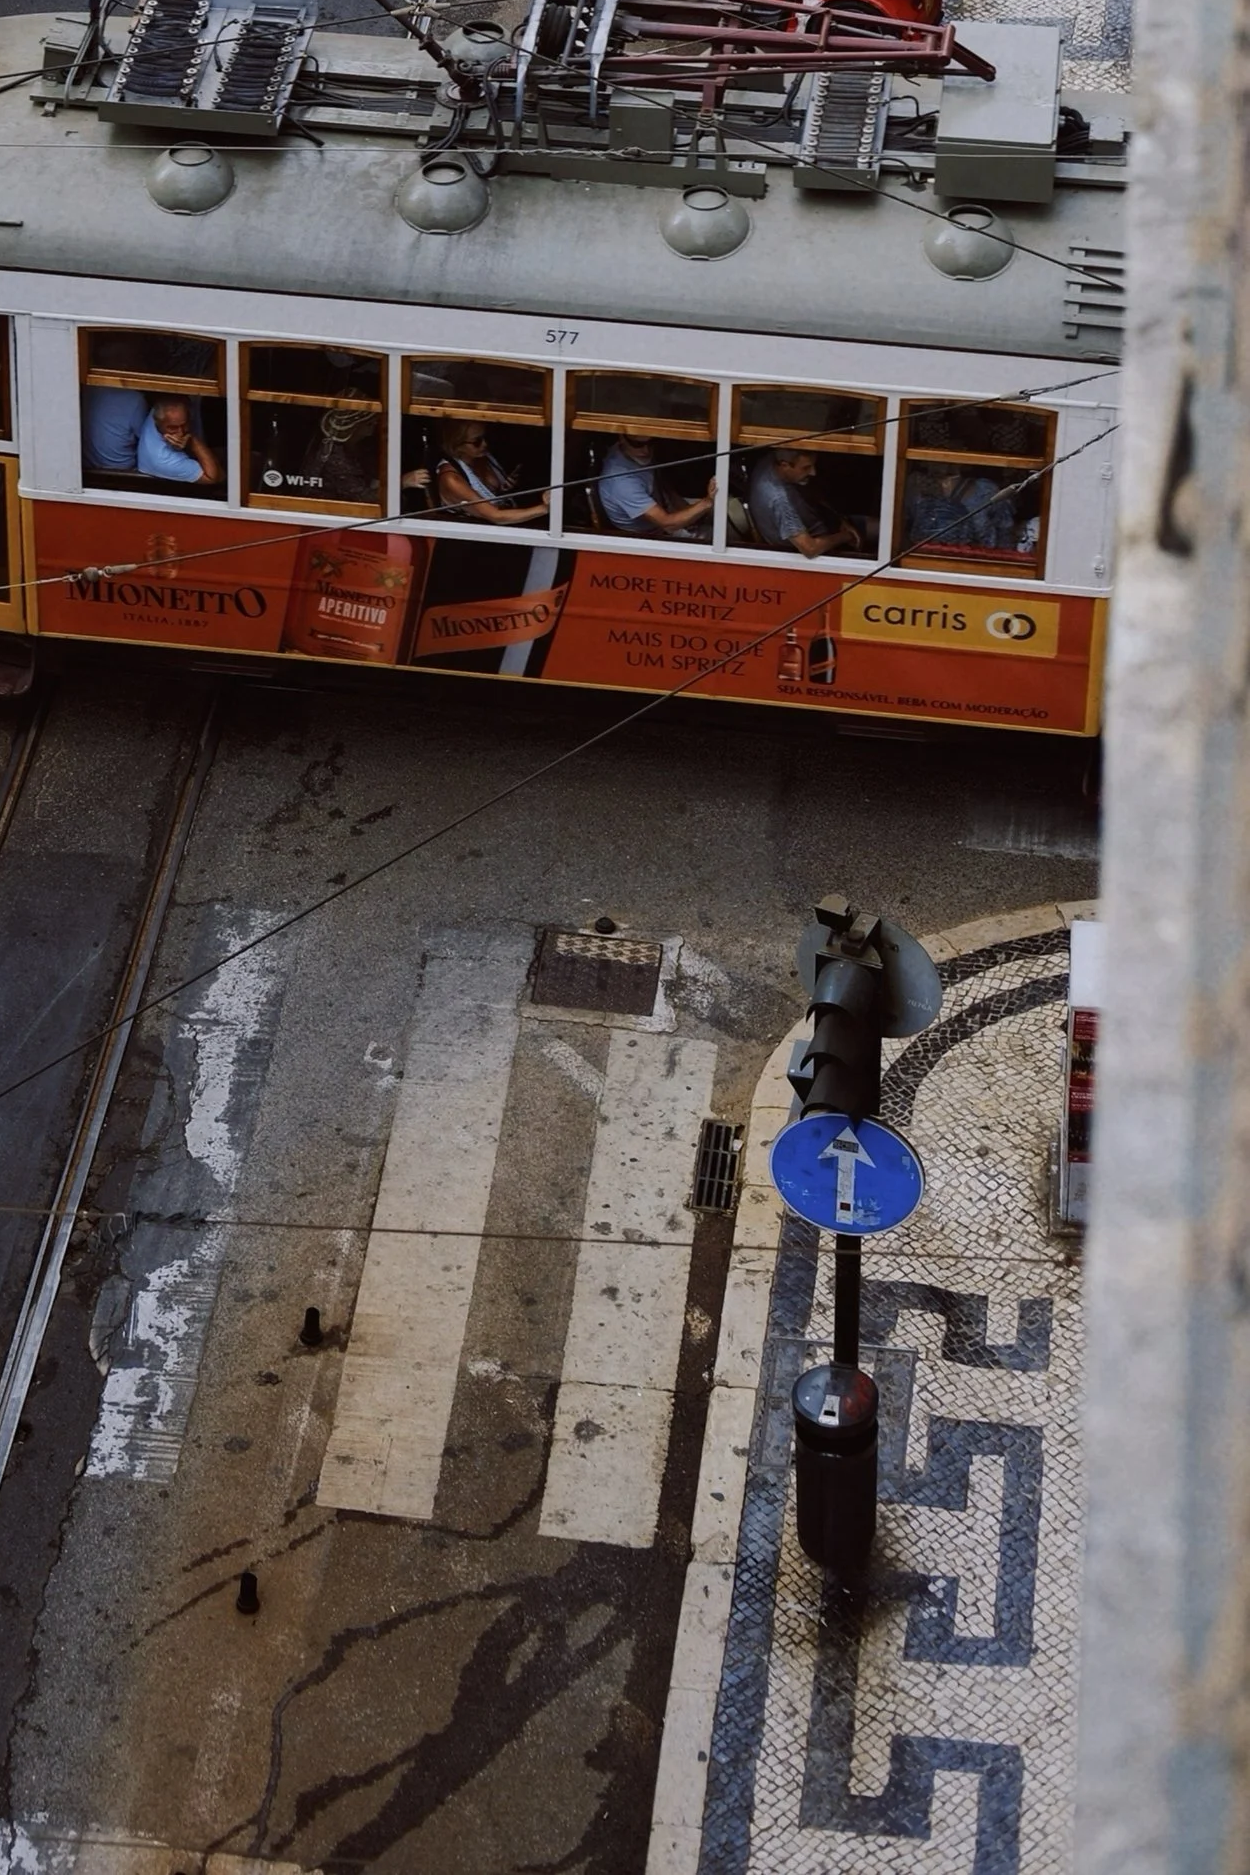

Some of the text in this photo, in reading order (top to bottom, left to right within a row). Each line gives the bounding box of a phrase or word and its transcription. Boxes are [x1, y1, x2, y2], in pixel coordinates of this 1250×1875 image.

[545, 329, 580, 345] 577
[285, 474, 323, 488] WI-FI
[65, 572, 268, 619] MIONETTO
[589, 574, 787, 606] MORE THAN JUST
[317, 596, 388, 625] APERITIVO
[429, 603, 550, 638] MIONETTO
[637, 598, 736, 622] A SPRITZ
[863, 603, 968, 631] carris
[607, 629, 765, 658] MAIS DO QUE
[625, 651, 747, 676] UM SPRITZ
[777, 684, 802, 697] SEJA
[897, 696, 928, 707] BEBA
[931, 699, 963, 711] COM
[965, 702, 1049, 720] MODERAÇÃO
